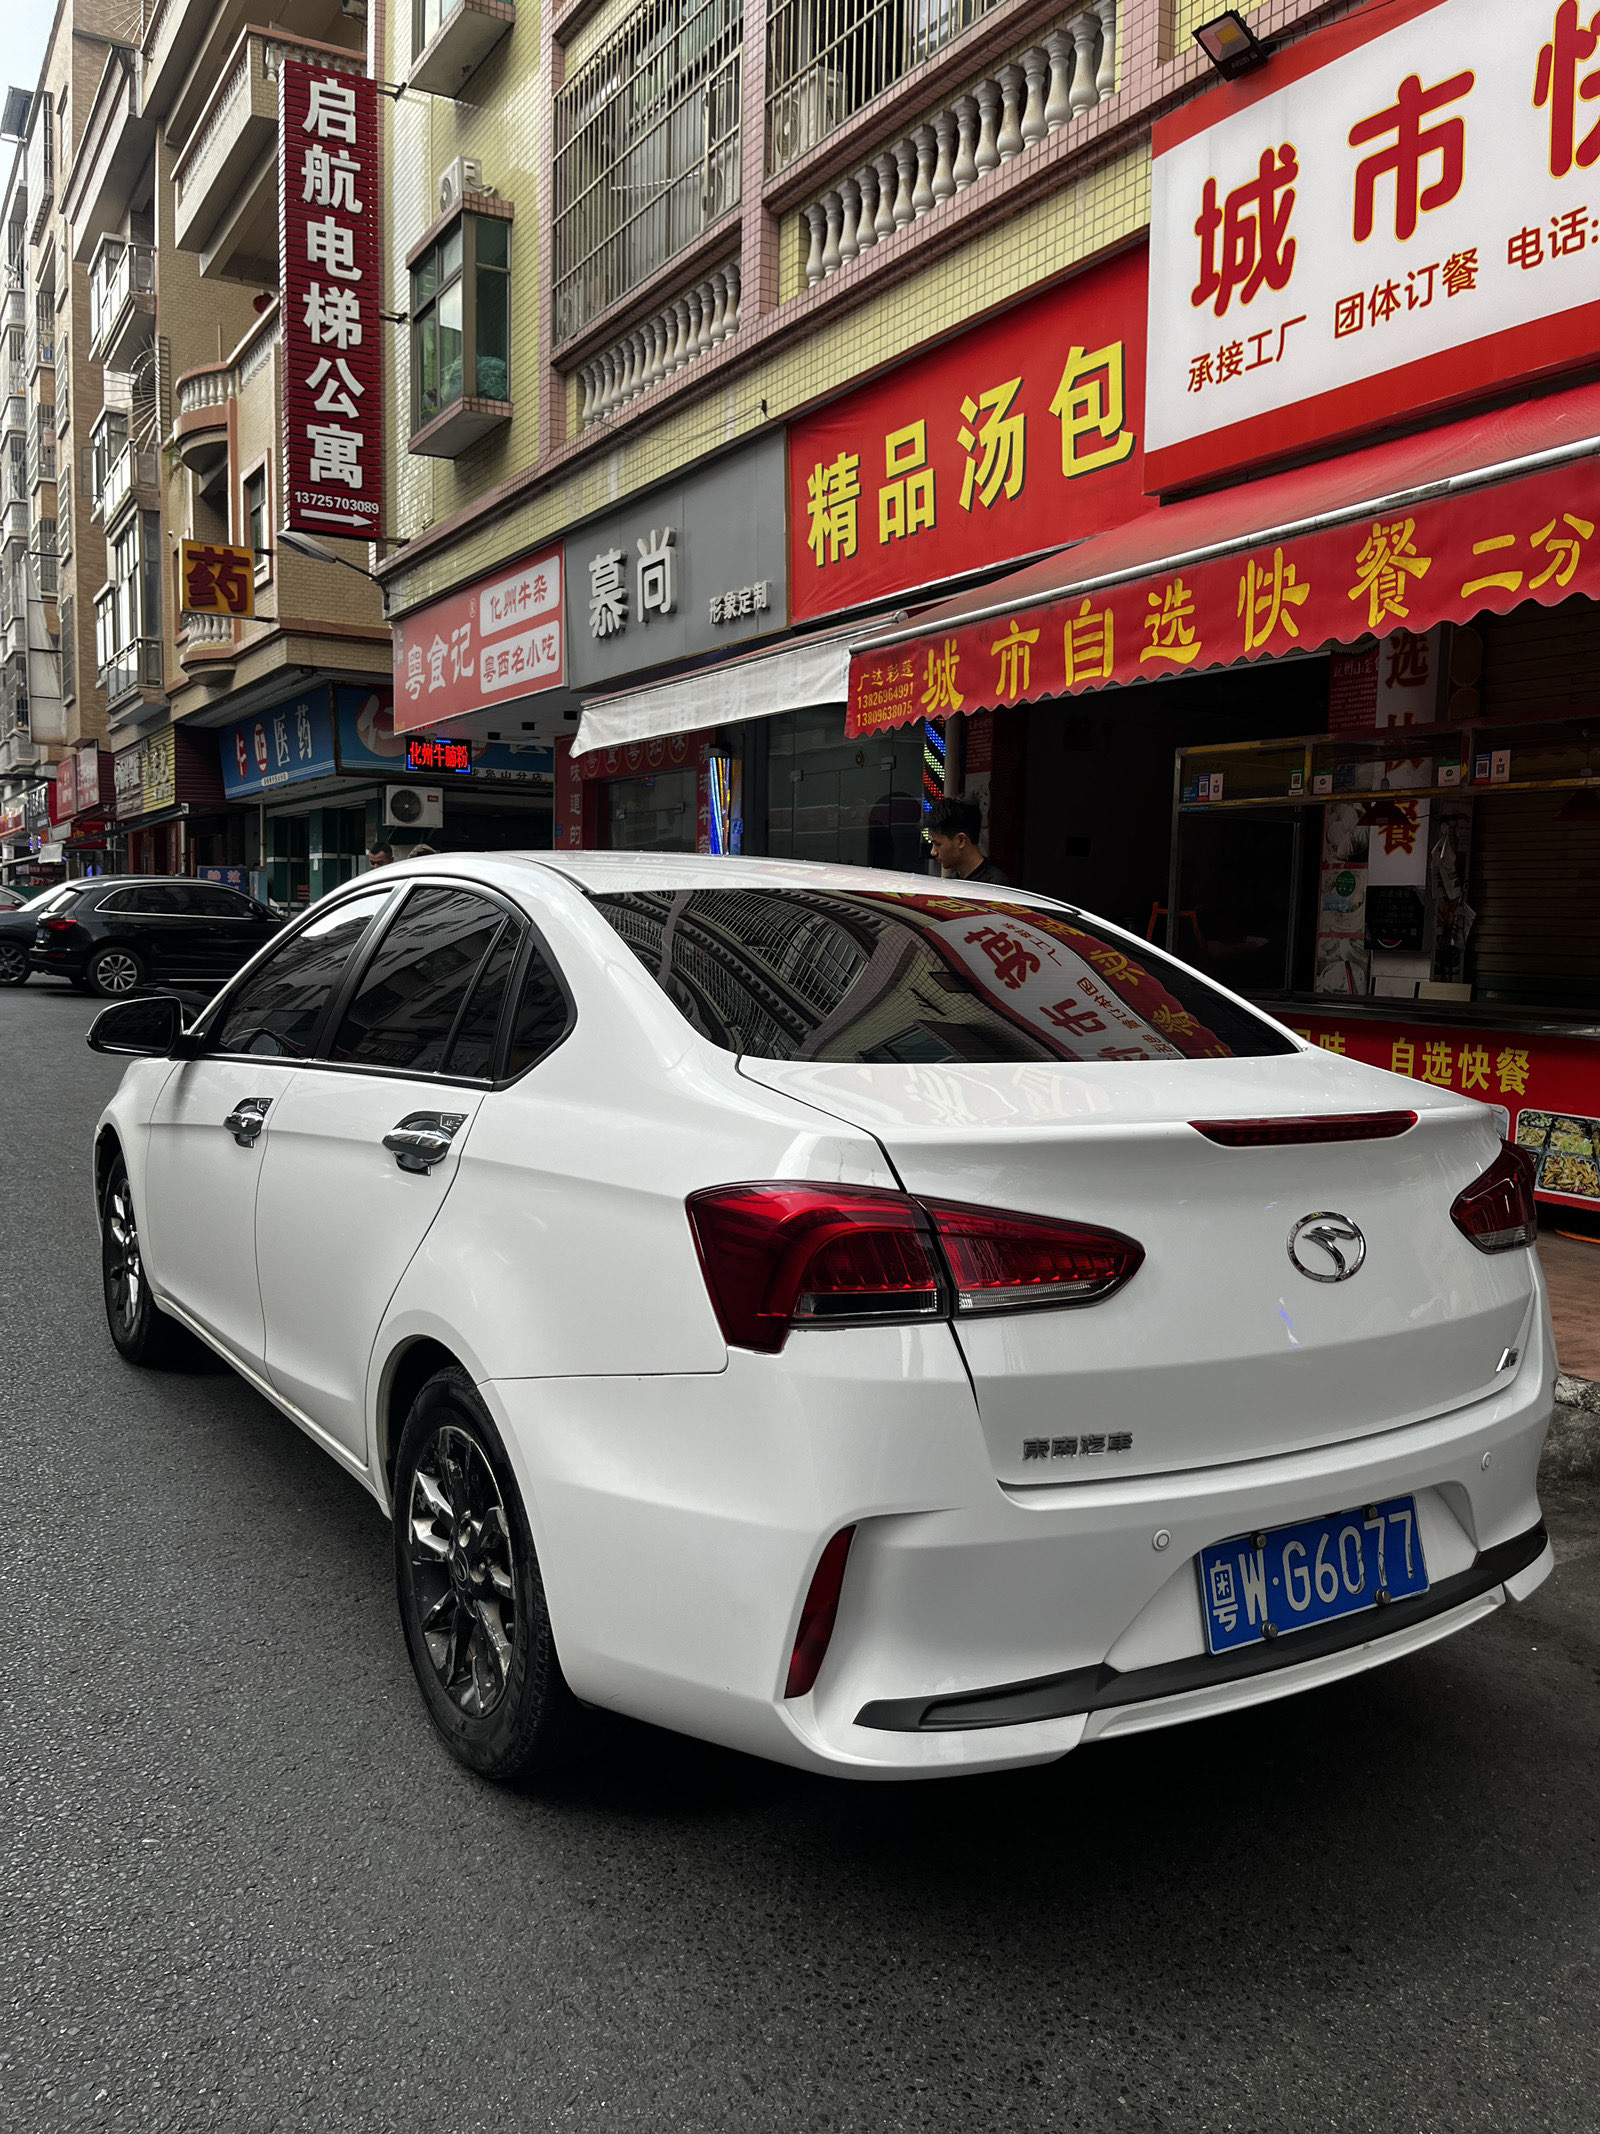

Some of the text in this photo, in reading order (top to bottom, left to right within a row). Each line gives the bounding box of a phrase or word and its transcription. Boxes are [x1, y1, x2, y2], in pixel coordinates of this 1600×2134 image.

[302, 78, 365, 489] 启航电梯公寓
[1187, 314, 1307, 393] 承接工厂
[1334, 247, 1479, 339] 团体订餐
[807, 340, 1135, 567] 精品汤包
[295, 491, 379, 515] 13725703089
[187, 546, 251, 612] 药
[490, 574, 548, 623] 化州牛杂
[589, 526, 676, 639] 慕尚
[709, 580, 773, 624] 形象定制
[483, 633, 556, 683] 粤西名小吃
[856, 700, 913, 727] 13809638075
[857, 682, 914, 710] 13826964991
[410, 741, 468, 769] 化州牛腩粉
[1391, 1036, 1530, 1096] 自选快餐
